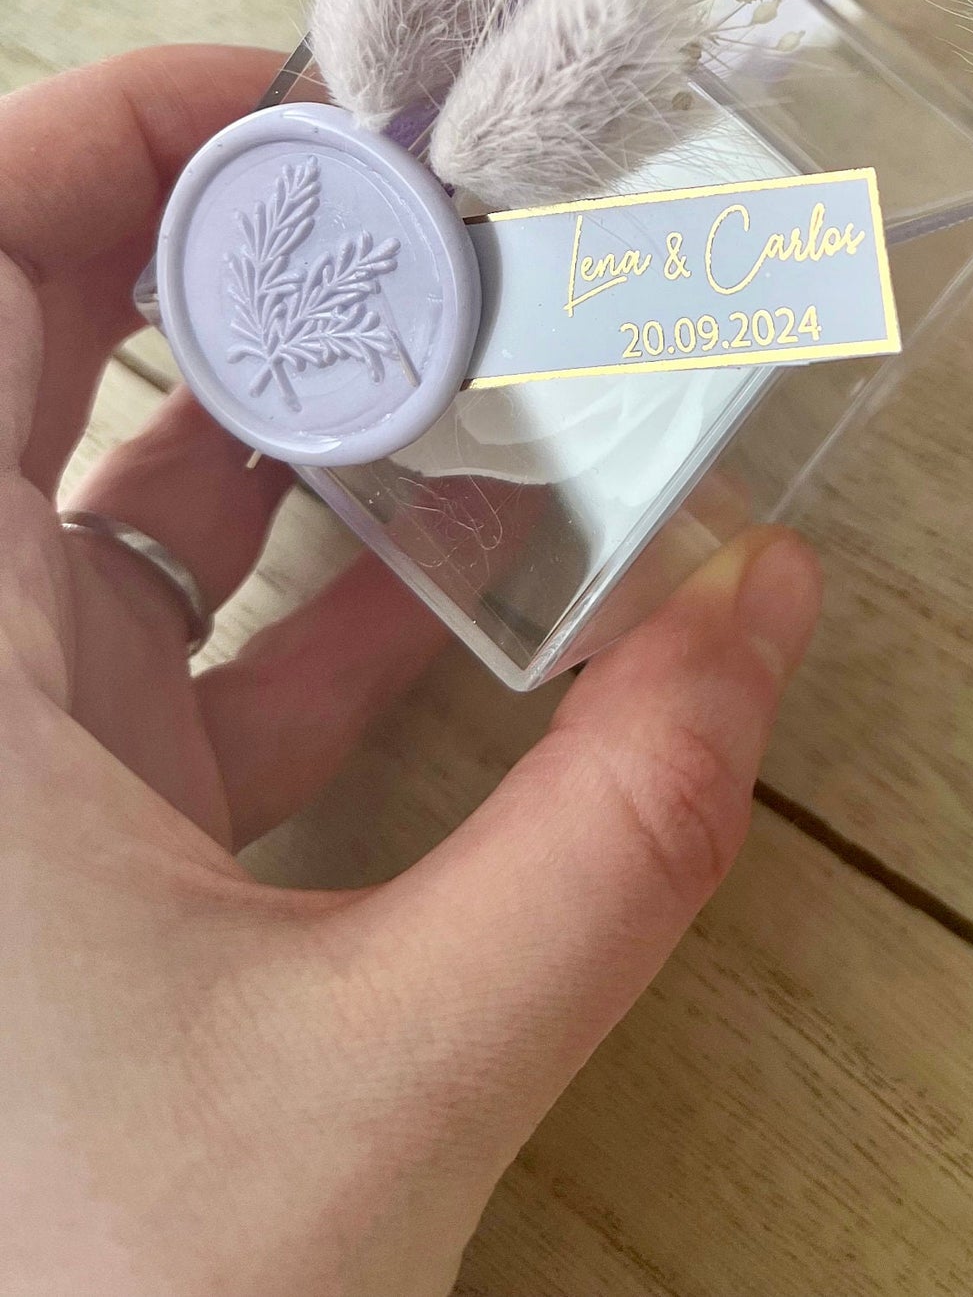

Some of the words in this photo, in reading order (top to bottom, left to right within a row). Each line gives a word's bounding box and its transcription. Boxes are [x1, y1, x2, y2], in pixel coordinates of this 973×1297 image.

[563, 215, 652, 318] Lena
[663, 232, 691, 280] &
[705, 203, 866, 295] Carlos
[620, 305, 822, 359] 20.09.2024
